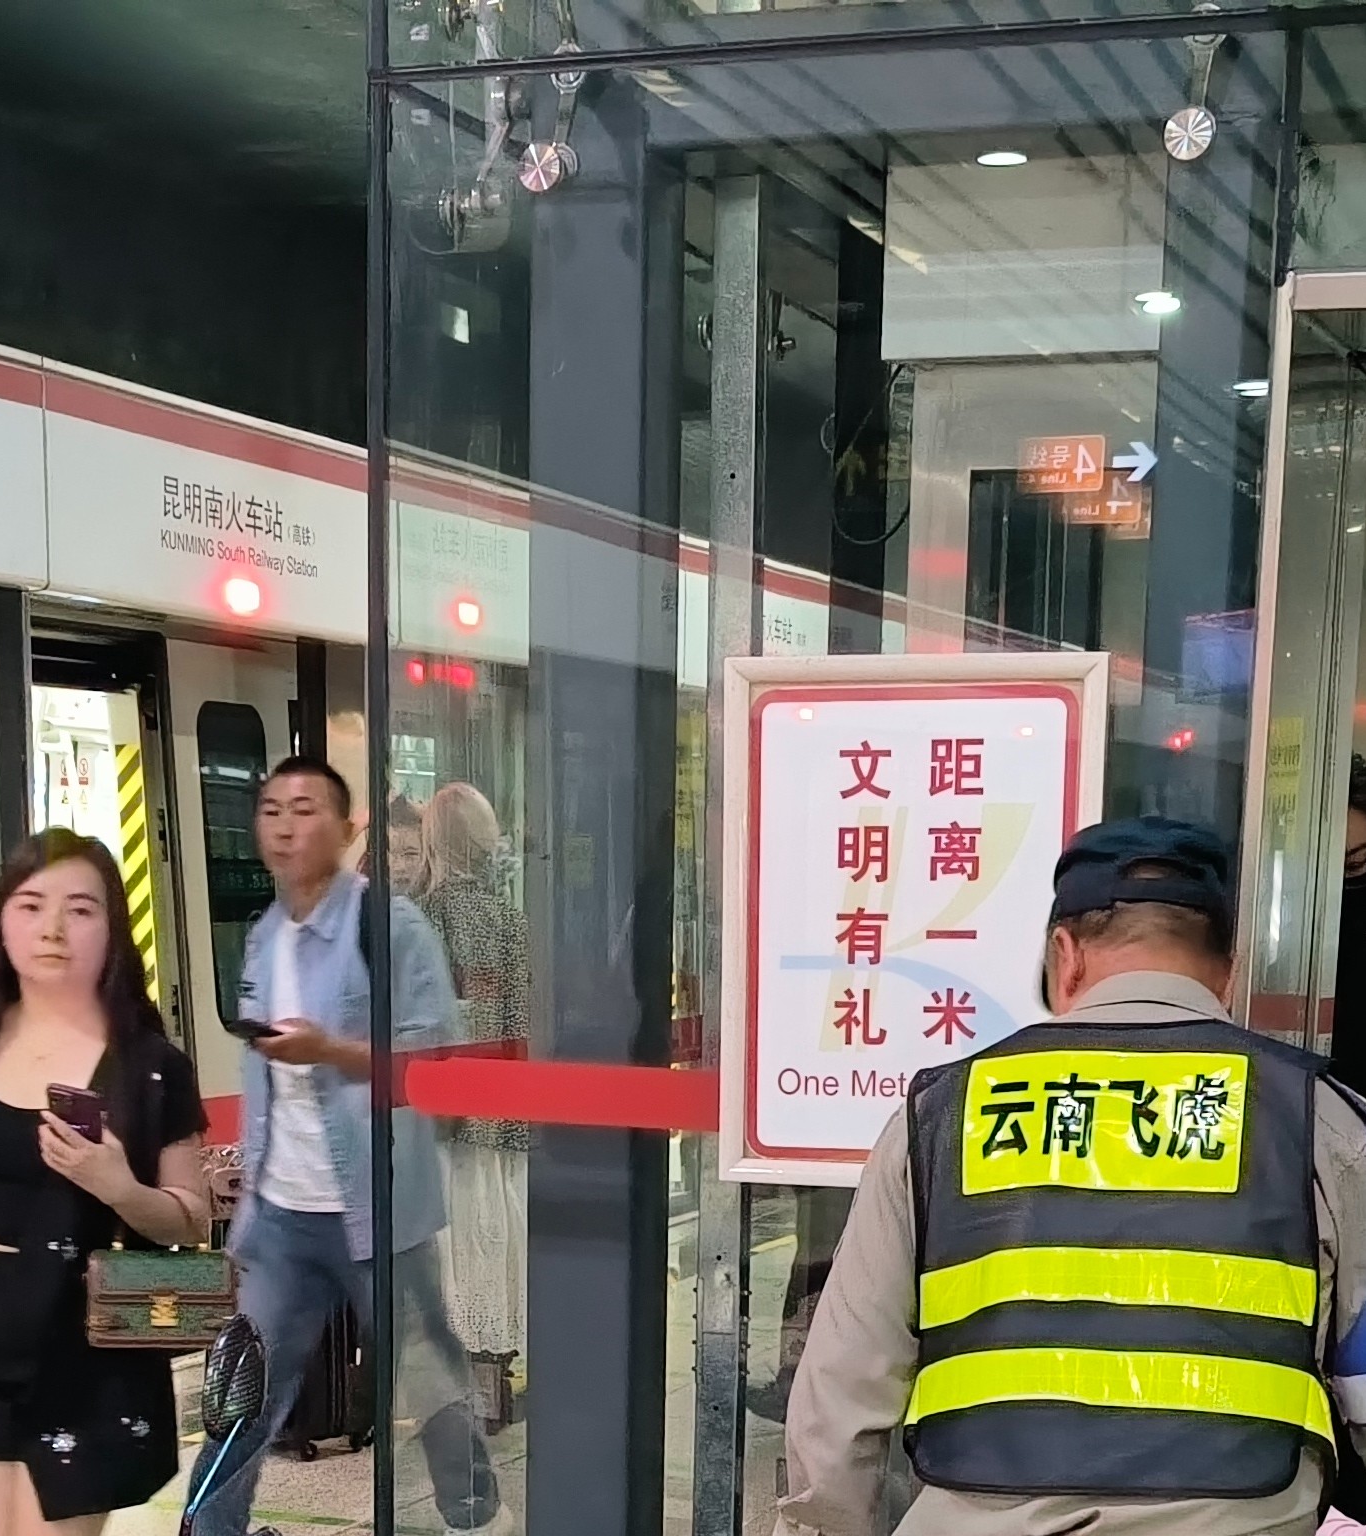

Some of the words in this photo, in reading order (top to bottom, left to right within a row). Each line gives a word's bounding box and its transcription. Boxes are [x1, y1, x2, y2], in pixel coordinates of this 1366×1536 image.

[160, 529, 215, 557] KUNMING
[217, 541, 246, 564] South
[248, 547, 285, 576] Railway
[287, 555, 318, 578] Station
[833, 739, 892, 1047] 文明有礼
[922, 738, 986, 1046] 距离一米
[777, 1068, 840, 1098] One
[980, 1073, 1229, 1161] 云南飞虎
